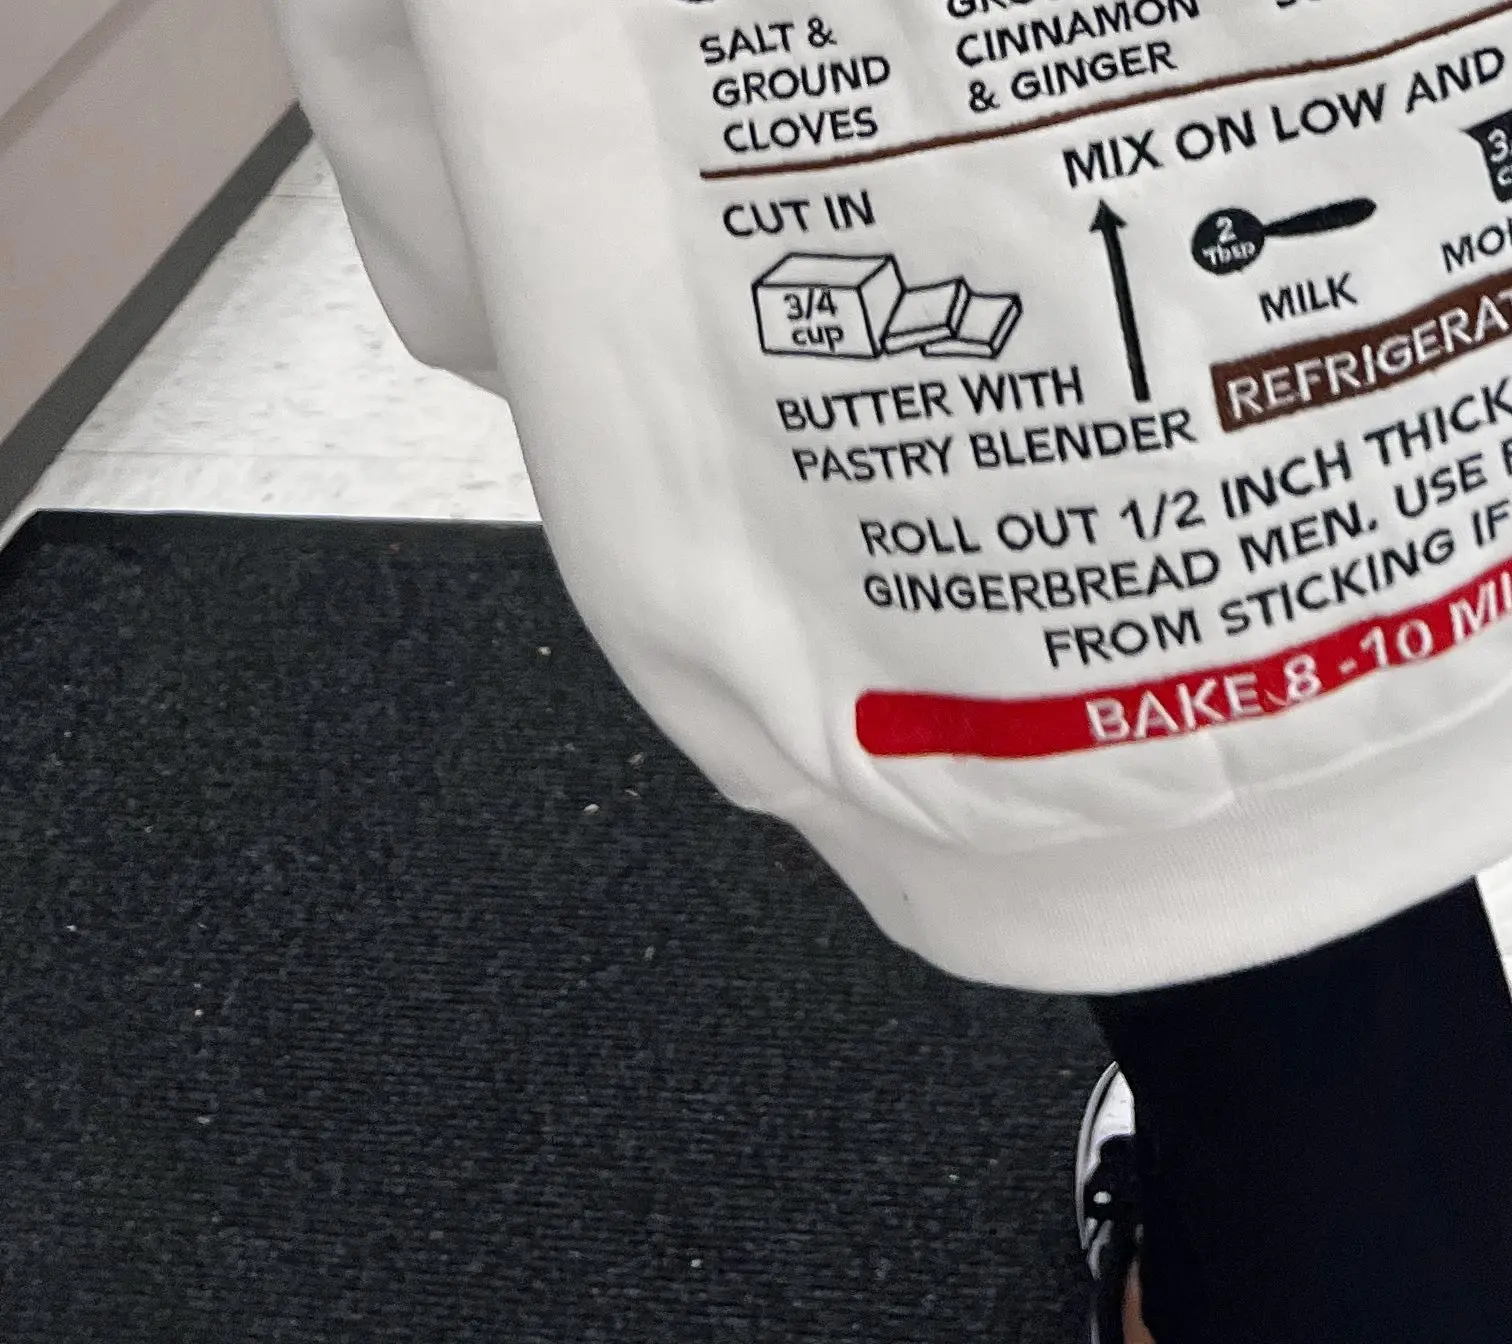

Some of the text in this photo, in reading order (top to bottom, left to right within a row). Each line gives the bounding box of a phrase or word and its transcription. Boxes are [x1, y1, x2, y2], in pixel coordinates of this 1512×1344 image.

[699, 14, 838, 65] SALT &
[712, 54, 891, 109] GROUND
[967, 40, 1178, 113] & GINGER
[723, 106, 879, 152] CLOVES
[1062, 129, 1164, 189] MIX
[1175, 112, 1257, 163] ON
[1272, 82, 1388, 142] LOW
[1405, 46, 1505, 114] AND
[722, 188, 876, 238] CUT IN
[1214, 216, 1235, 242] 2
[783, 287, 839, 322] 3/4
[1259, 272, 1359, 324] MILK
[791, 325, 845, 352] cup
[776, 364, 1085, 432] BUTTER WITH
[792, 408, 1197, 483] PASTRY BLENDER
[860, 515, 980, 557] ROLL
[998, 505, 1099, 553] OUT
[1120, 487, 1205, 541] 1/2
[1221, 439, 1354, 518] INCH
[864, 550, 1220, 615] GINGERBREAD
[1240, 501, 1378, 573] MEN.
[1394, 452, 1489, 519] USE
[1043, 610, 1203, 670] FROM
[1222, 528, 1456, 637] STICKING
[1471, 499, 1510, 548] IF
[1085, 672, 1263, 742] BAKE
[1284, 653, 1321, 703] 8
